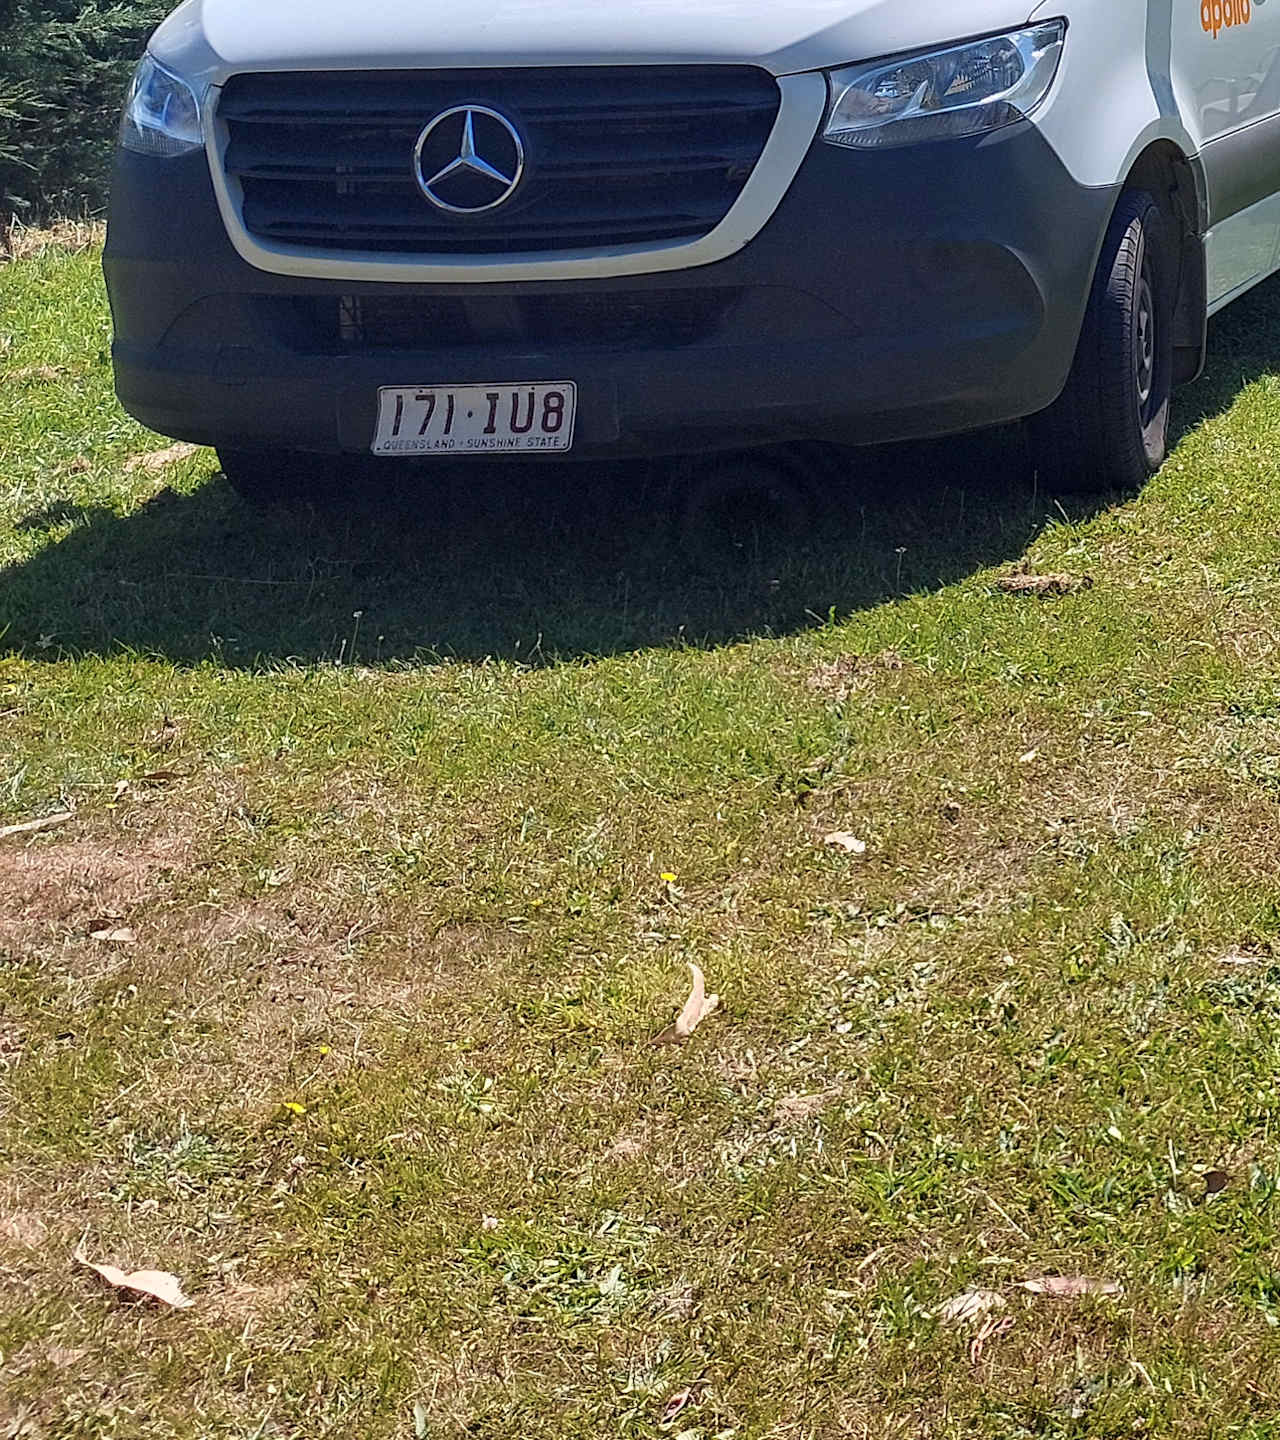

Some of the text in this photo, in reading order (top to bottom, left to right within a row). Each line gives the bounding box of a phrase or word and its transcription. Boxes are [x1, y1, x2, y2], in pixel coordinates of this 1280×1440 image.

[383, 436, 559, 450] QUEENSLAND SUNSHINE STATE
